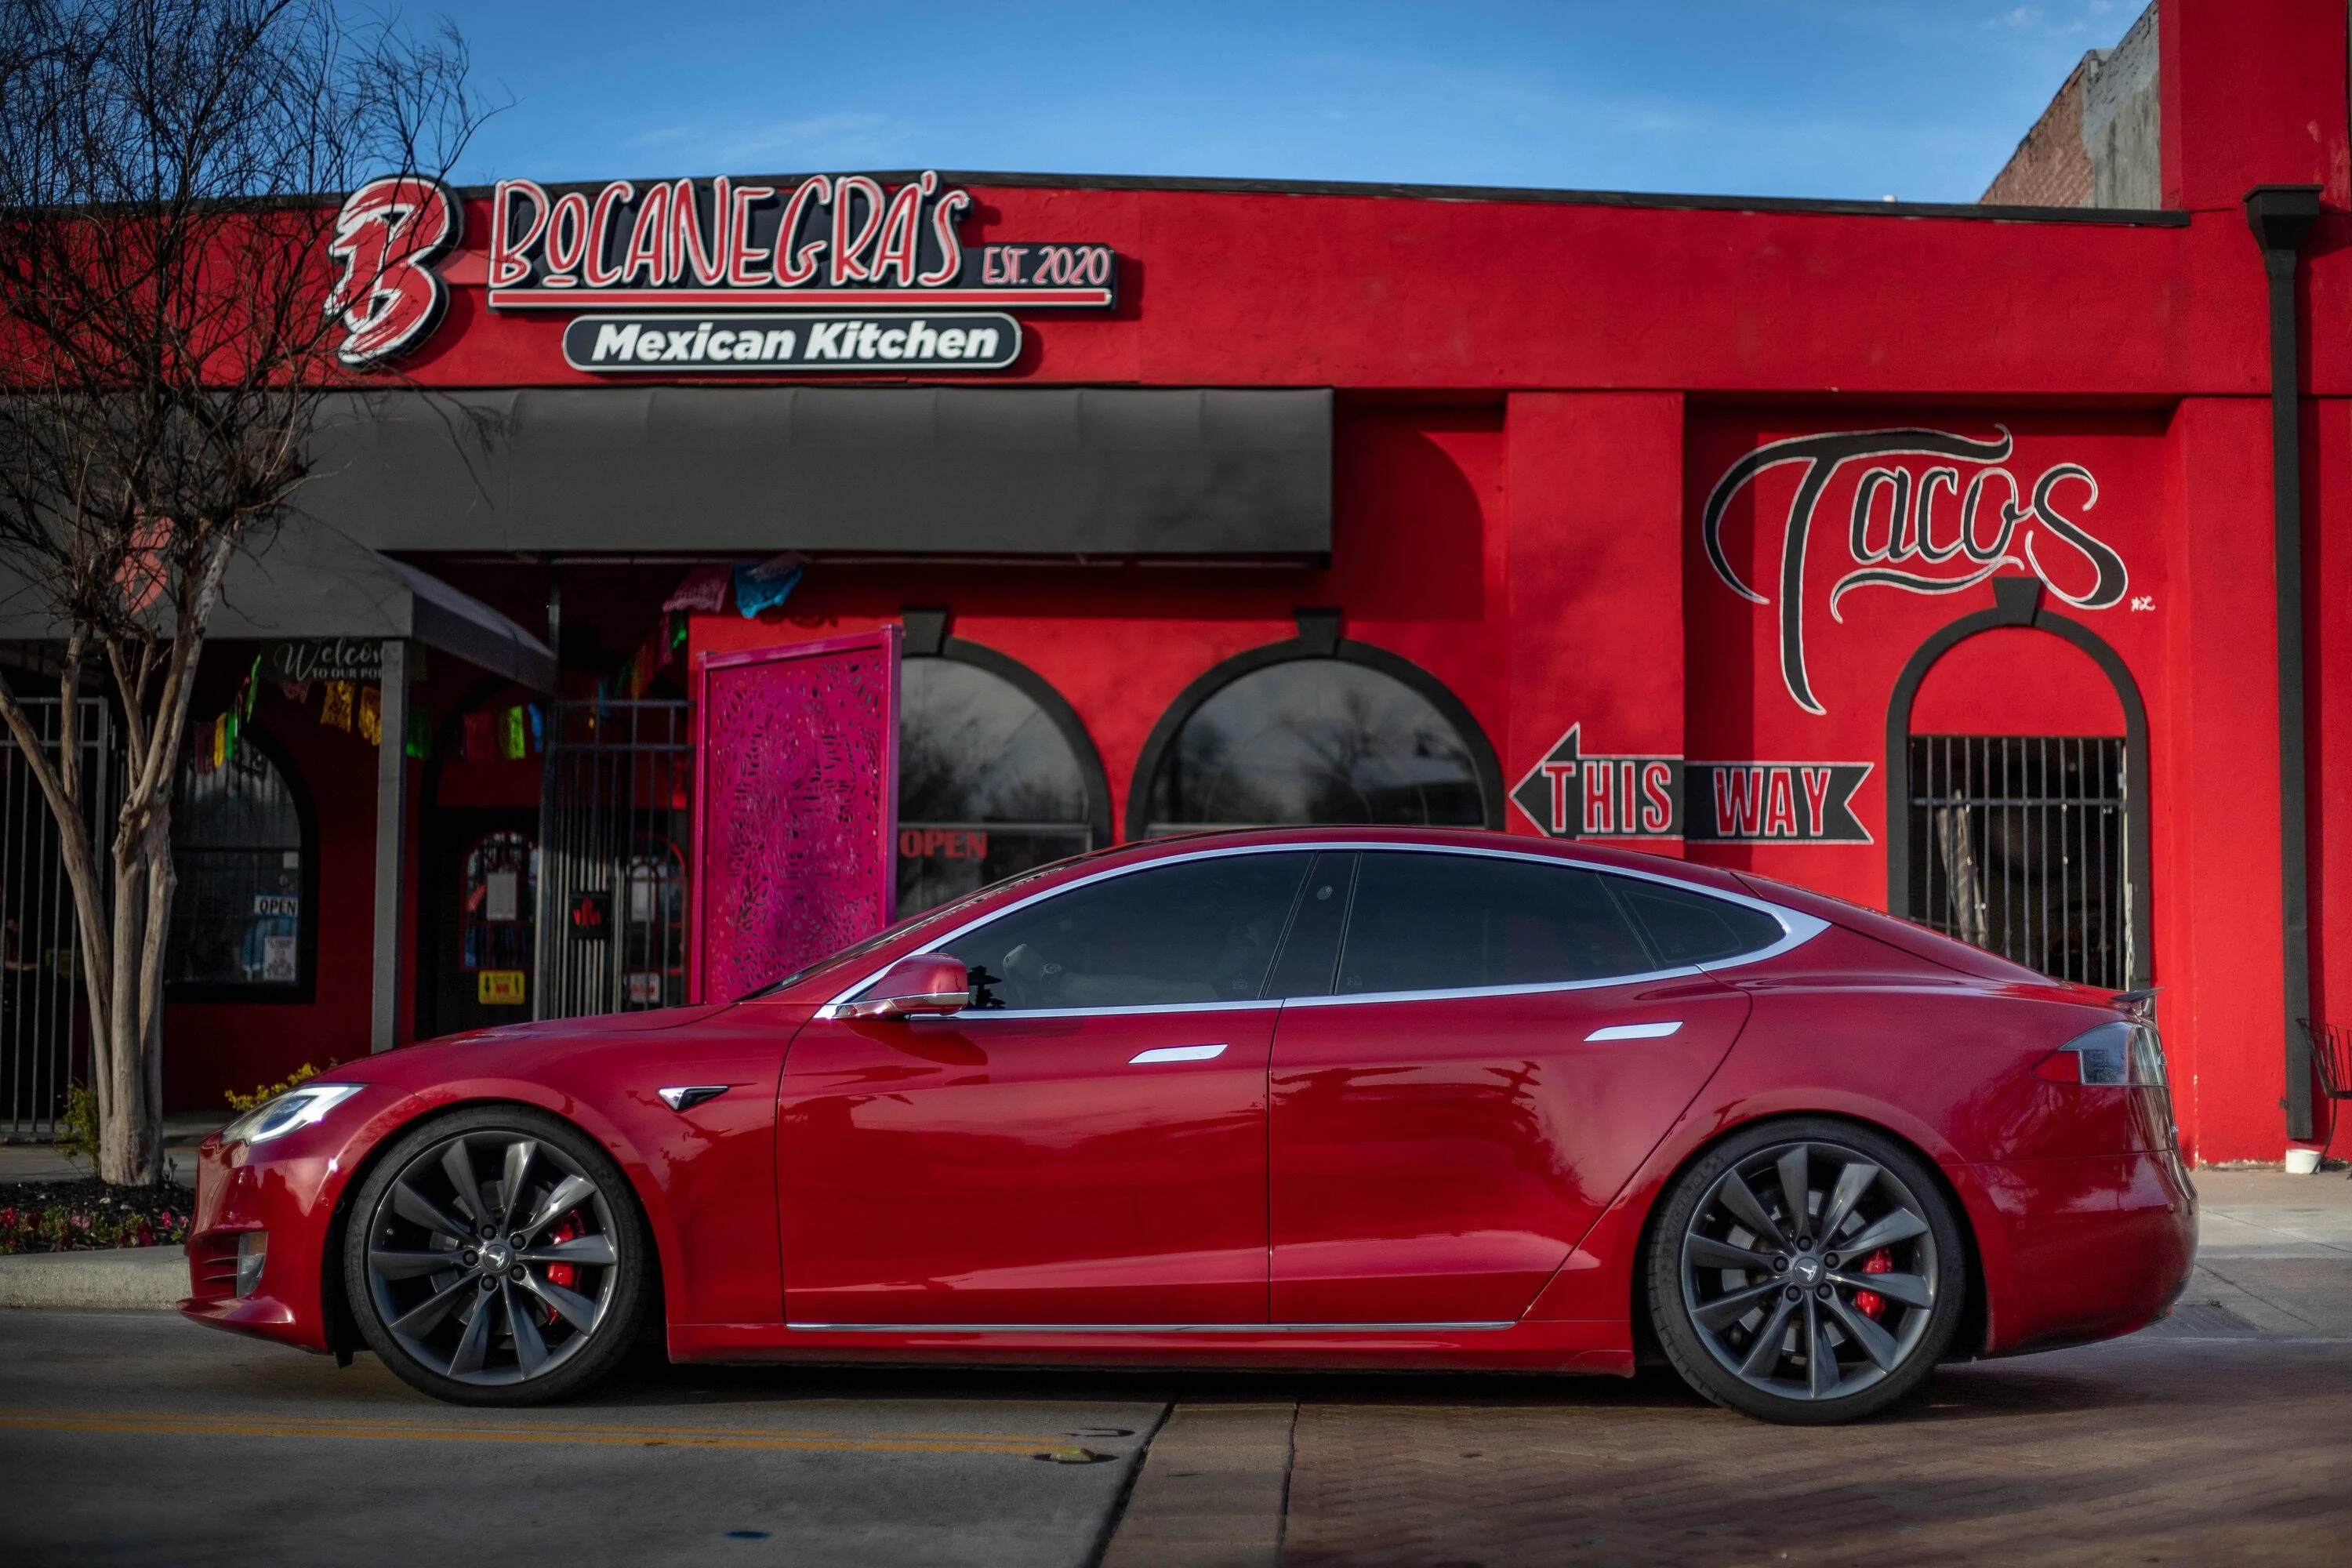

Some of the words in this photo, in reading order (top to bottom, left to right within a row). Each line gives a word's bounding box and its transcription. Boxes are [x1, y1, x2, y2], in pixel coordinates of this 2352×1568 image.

[982, 245, 1030, 285] EST.
[1032, 245, 1112, 285] 2020
[591, 322, 797, 362] Mexican
[804, 319, 999, 361] Kitchen
[1702, 423, 2129, 717] Tacos
[331, 667, 357, 679] OUR
[361, 667, 382, 679] PO
[1542, 760, 1673, 834] THIS
[1714, 768, 1832, 837] WAY
[899, 829, 989, 859] OPEN
[260, 898, 296, 915] OPEN
